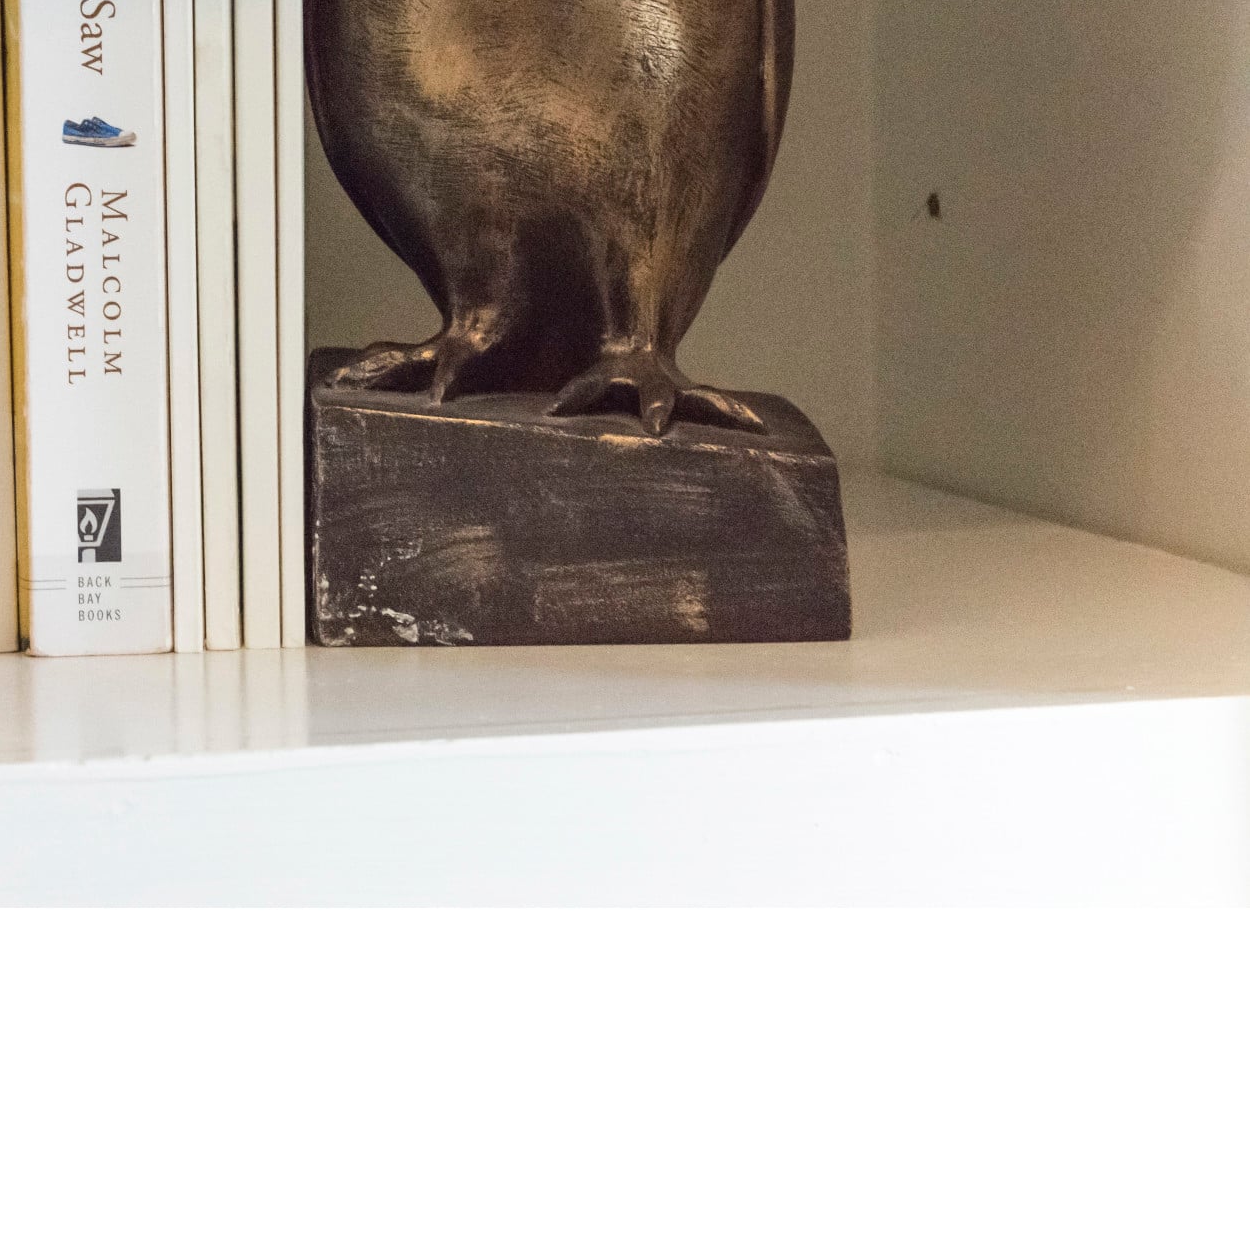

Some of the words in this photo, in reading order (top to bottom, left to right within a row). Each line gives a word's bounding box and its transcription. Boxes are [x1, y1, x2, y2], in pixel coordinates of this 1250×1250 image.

[64, 182, 92, 385] GLADWELL
[101, 189, 128, 375] MALCOLM
[77, 575, 112, 588] BACK
[77, 592, 102, 605] BAY
[77, 608, 122, 621] BOOKS
